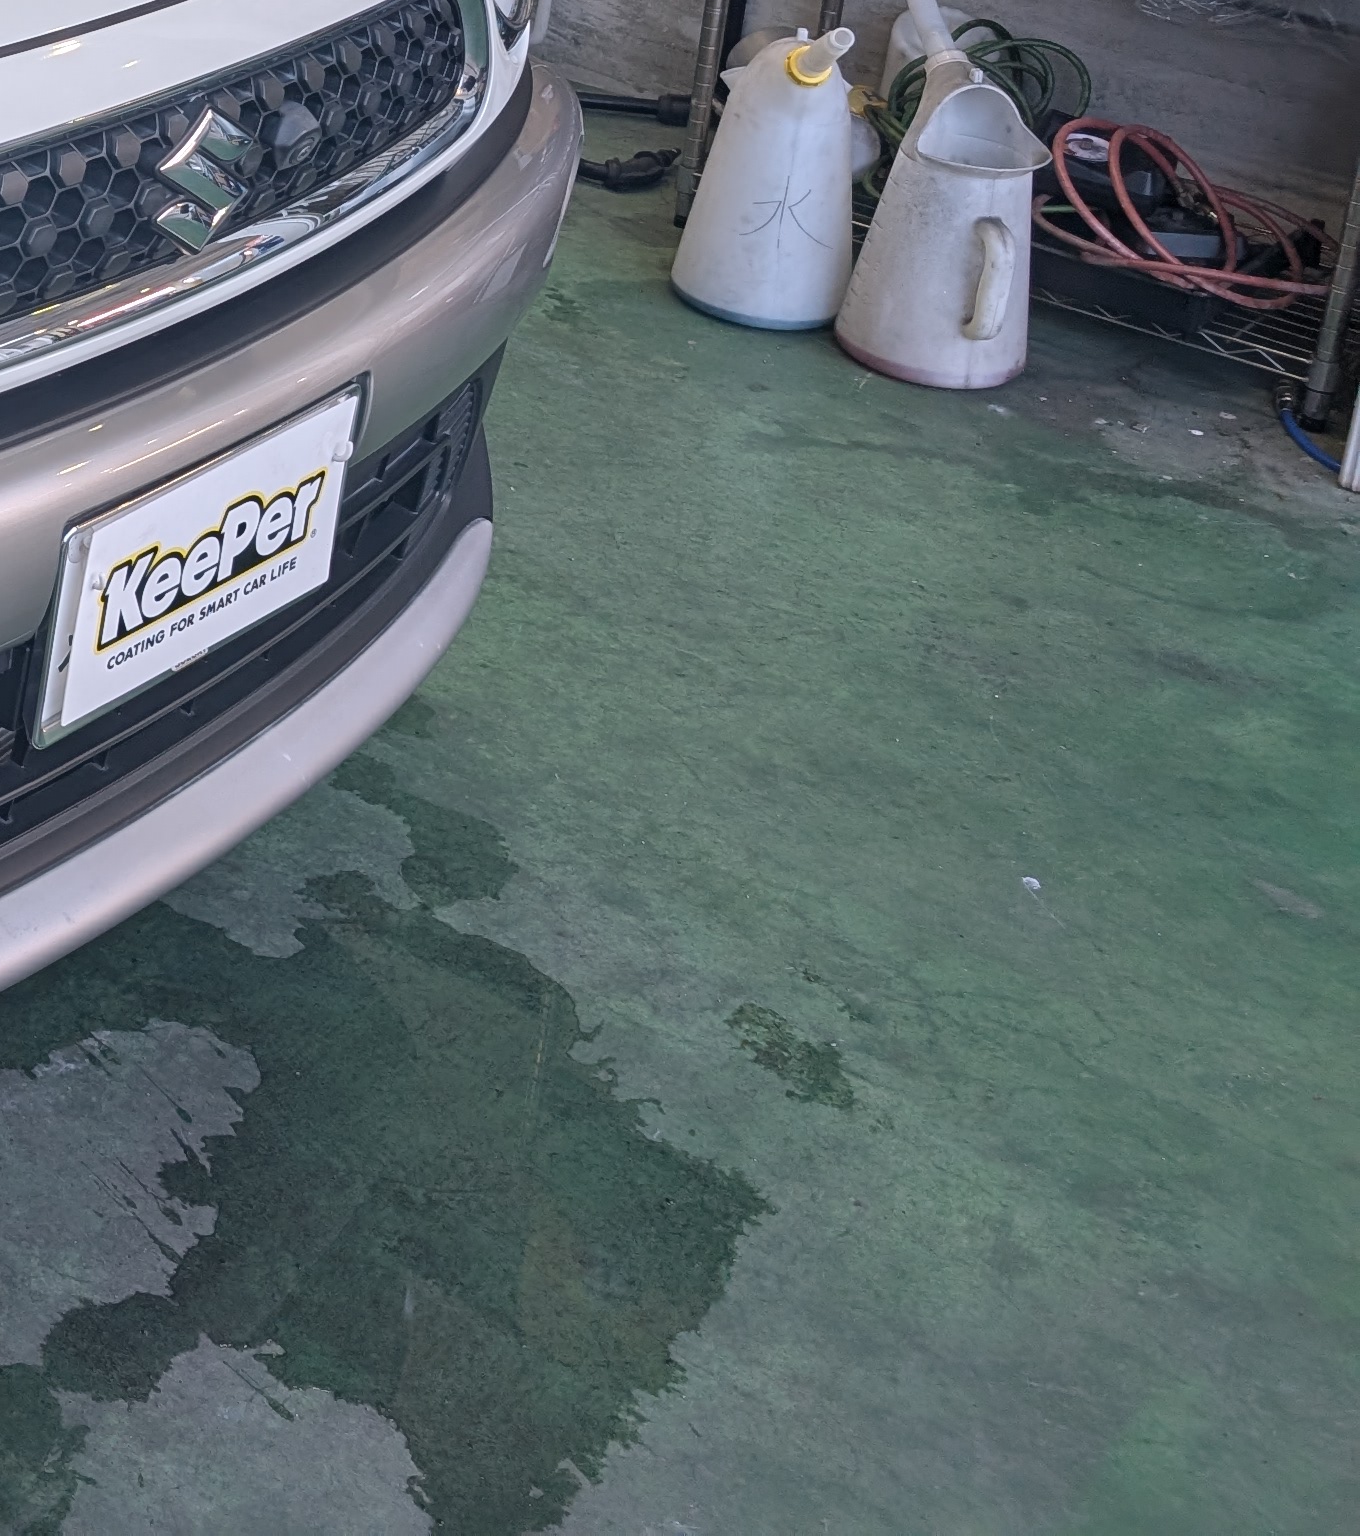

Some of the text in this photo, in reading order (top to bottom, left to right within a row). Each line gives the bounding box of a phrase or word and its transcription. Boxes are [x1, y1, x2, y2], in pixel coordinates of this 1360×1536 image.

[97, 469, 326, 651] KeePer
[107, 630, 165, 670] COATING
[169, 613, 195, 636] FOR
[198, 588, 240, 621] SMART
[243, 573, 266, 595] CAR
[270, 556, 298, 581] LIFE
